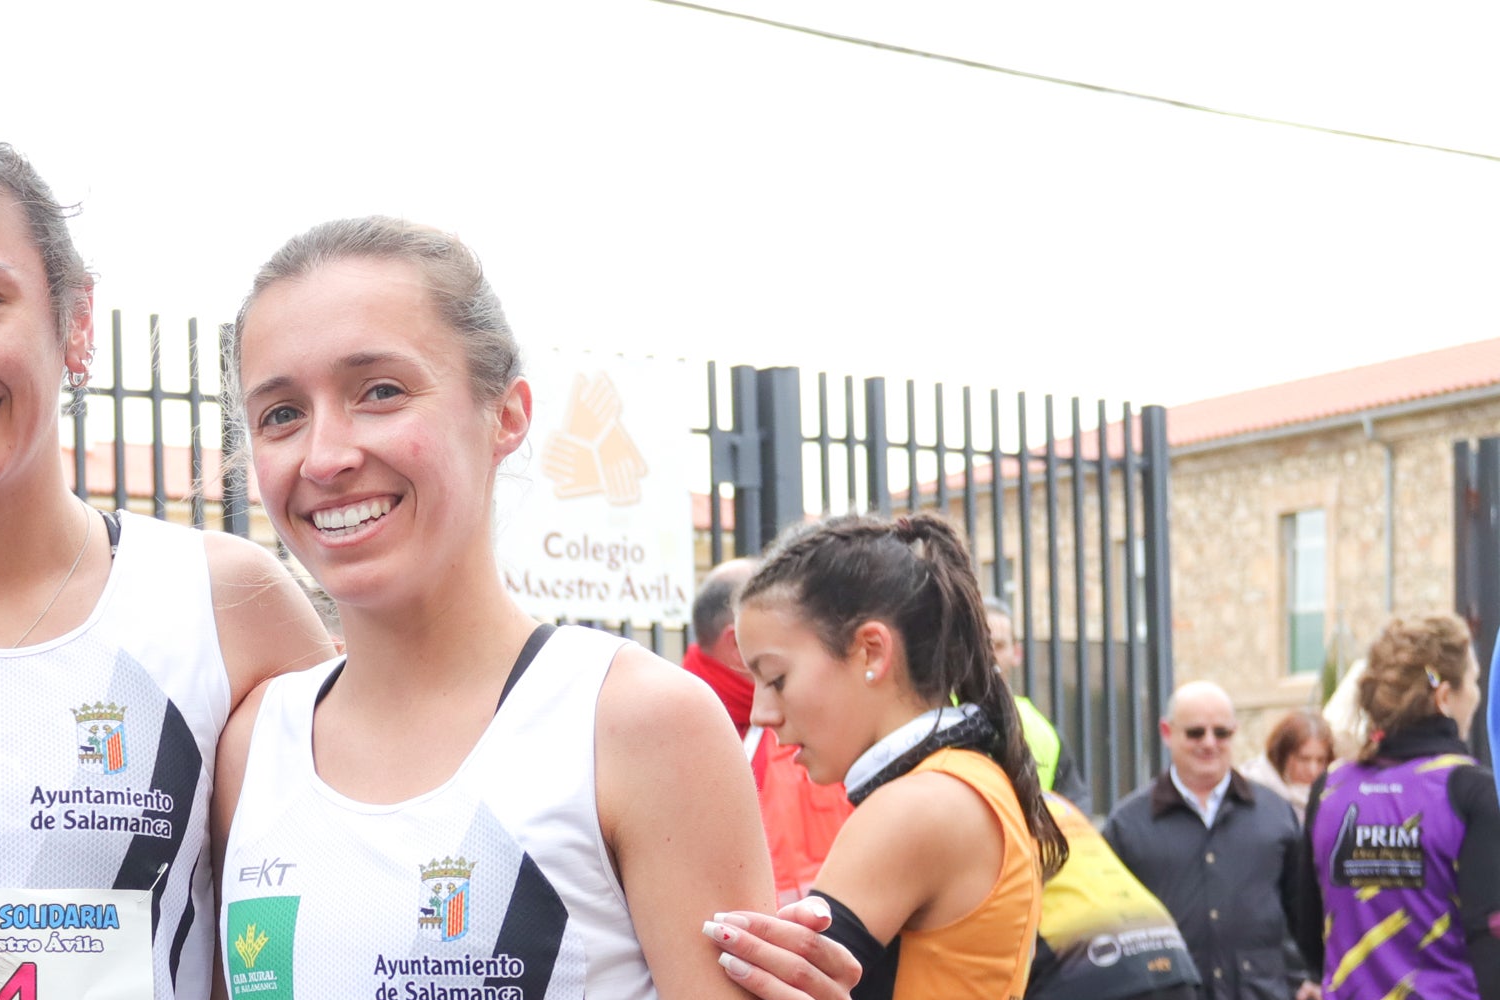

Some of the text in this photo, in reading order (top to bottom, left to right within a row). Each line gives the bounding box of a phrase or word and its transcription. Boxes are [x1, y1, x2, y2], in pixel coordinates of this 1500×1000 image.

[544, 532, 645, 571] Colegio
[30, 785, 174, 812] Ayuntamiento
[30, 810, 172, 838] de Salamanca
[1356, 825, 1419, 848] PRIM
[239, 857, 297, 888] EKT
[45, 931, 105, 953] Ávila
[248, 970, 278, 983] RURAL
[373, 954, 525, 980] Ayuntamiento
